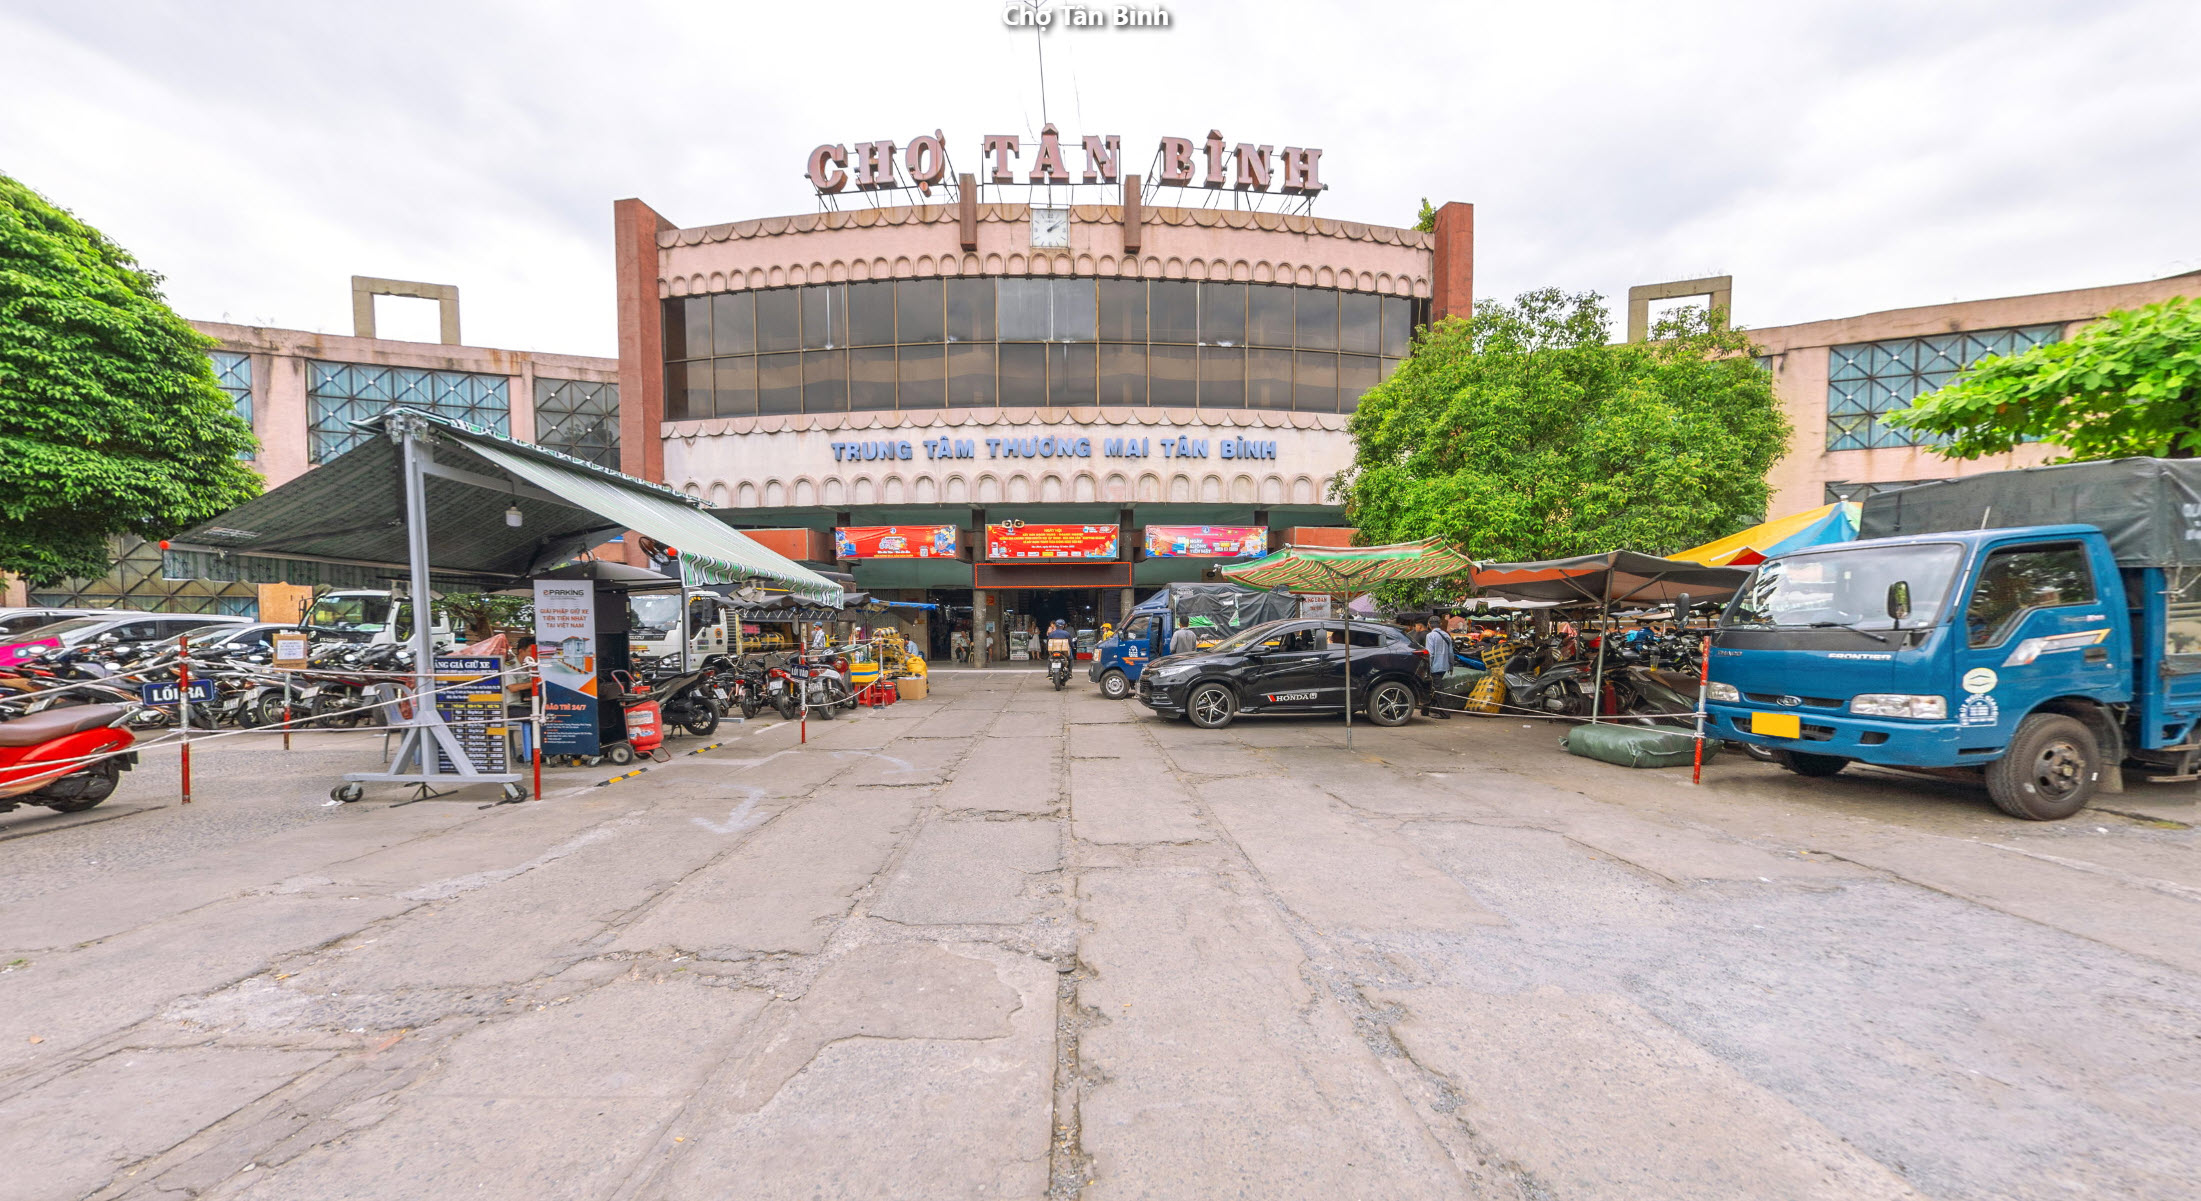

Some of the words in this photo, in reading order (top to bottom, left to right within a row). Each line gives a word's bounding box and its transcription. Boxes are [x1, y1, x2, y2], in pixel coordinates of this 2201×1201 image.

[807, 128, 947, 198] CHỢ
[984, 123, 1121, 185] TÂN
[1159, 129, 1325, 196] BÌNH
[831, 440, 912, 461] TRUNG
[923, 436, 975, 459] TÂM
[986, 435, 1091, 458] THƯƠNG
[1161, 435, 1209, 459] TÂN
[1221, 435, 1277, 460] BÌNH
[450, 660, 464, 668] GIÁ
[465, 660, 478, 668] GIỮ
[152, 684, 178, 702] LỐI
